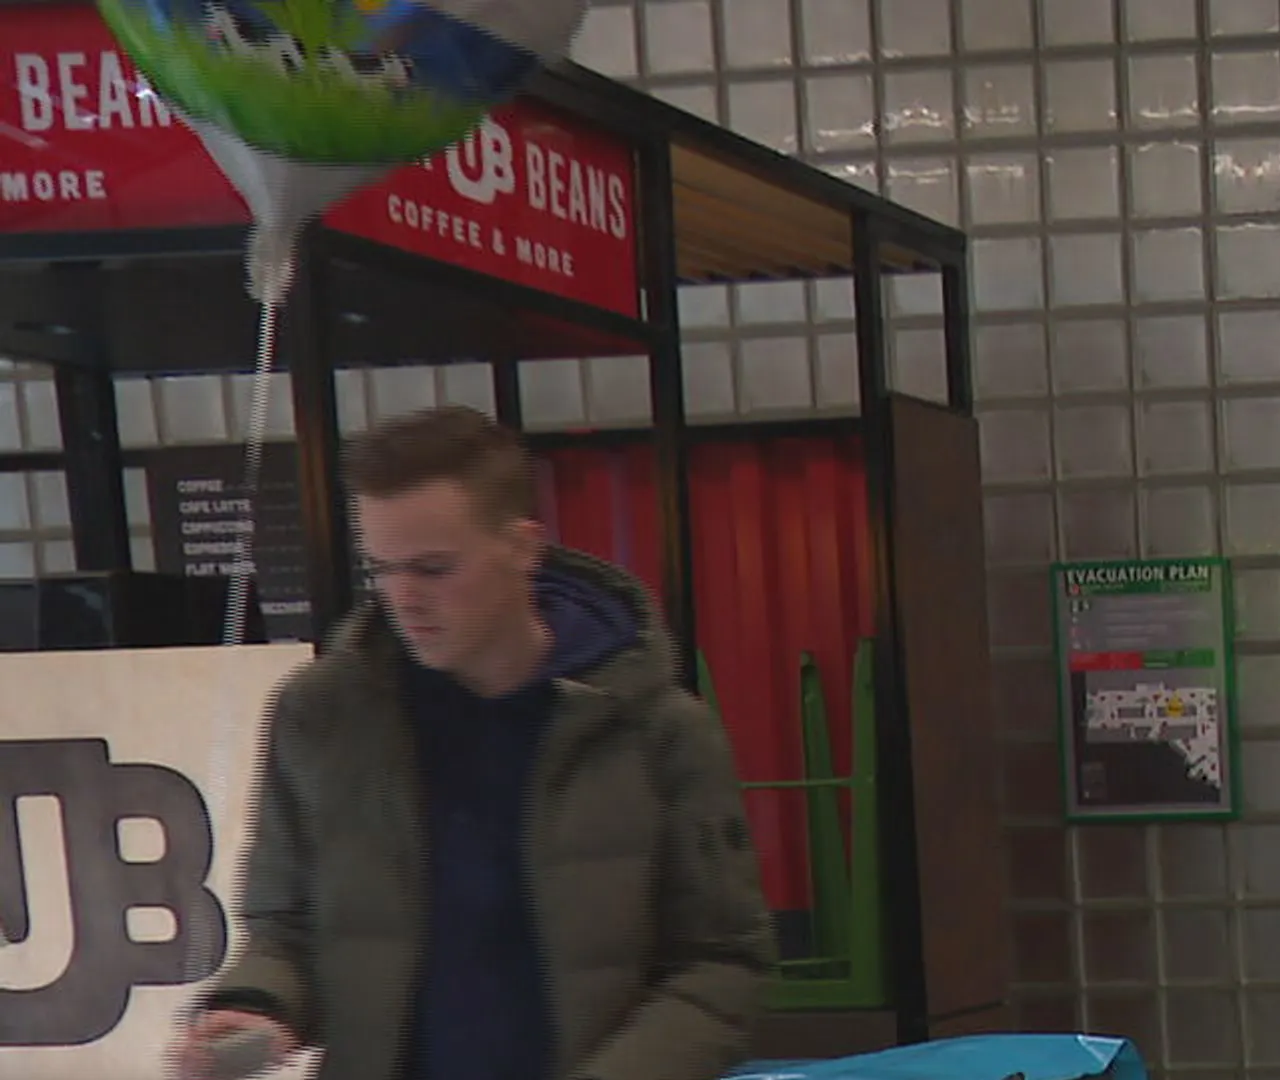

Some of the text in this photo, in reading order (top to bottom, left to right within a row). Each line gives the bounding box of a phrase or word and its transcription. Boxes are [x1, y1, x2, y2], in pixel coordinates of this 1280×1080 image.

[15, 50, 171, 131] BEAN
[0, 169, 107, 201] MORE
[526, 142, 626, 240] BEANS
[388, 193, 574, 277] COFFEE & MORE
[1067, 564, 1209, 585] EVACUATION PLAN
